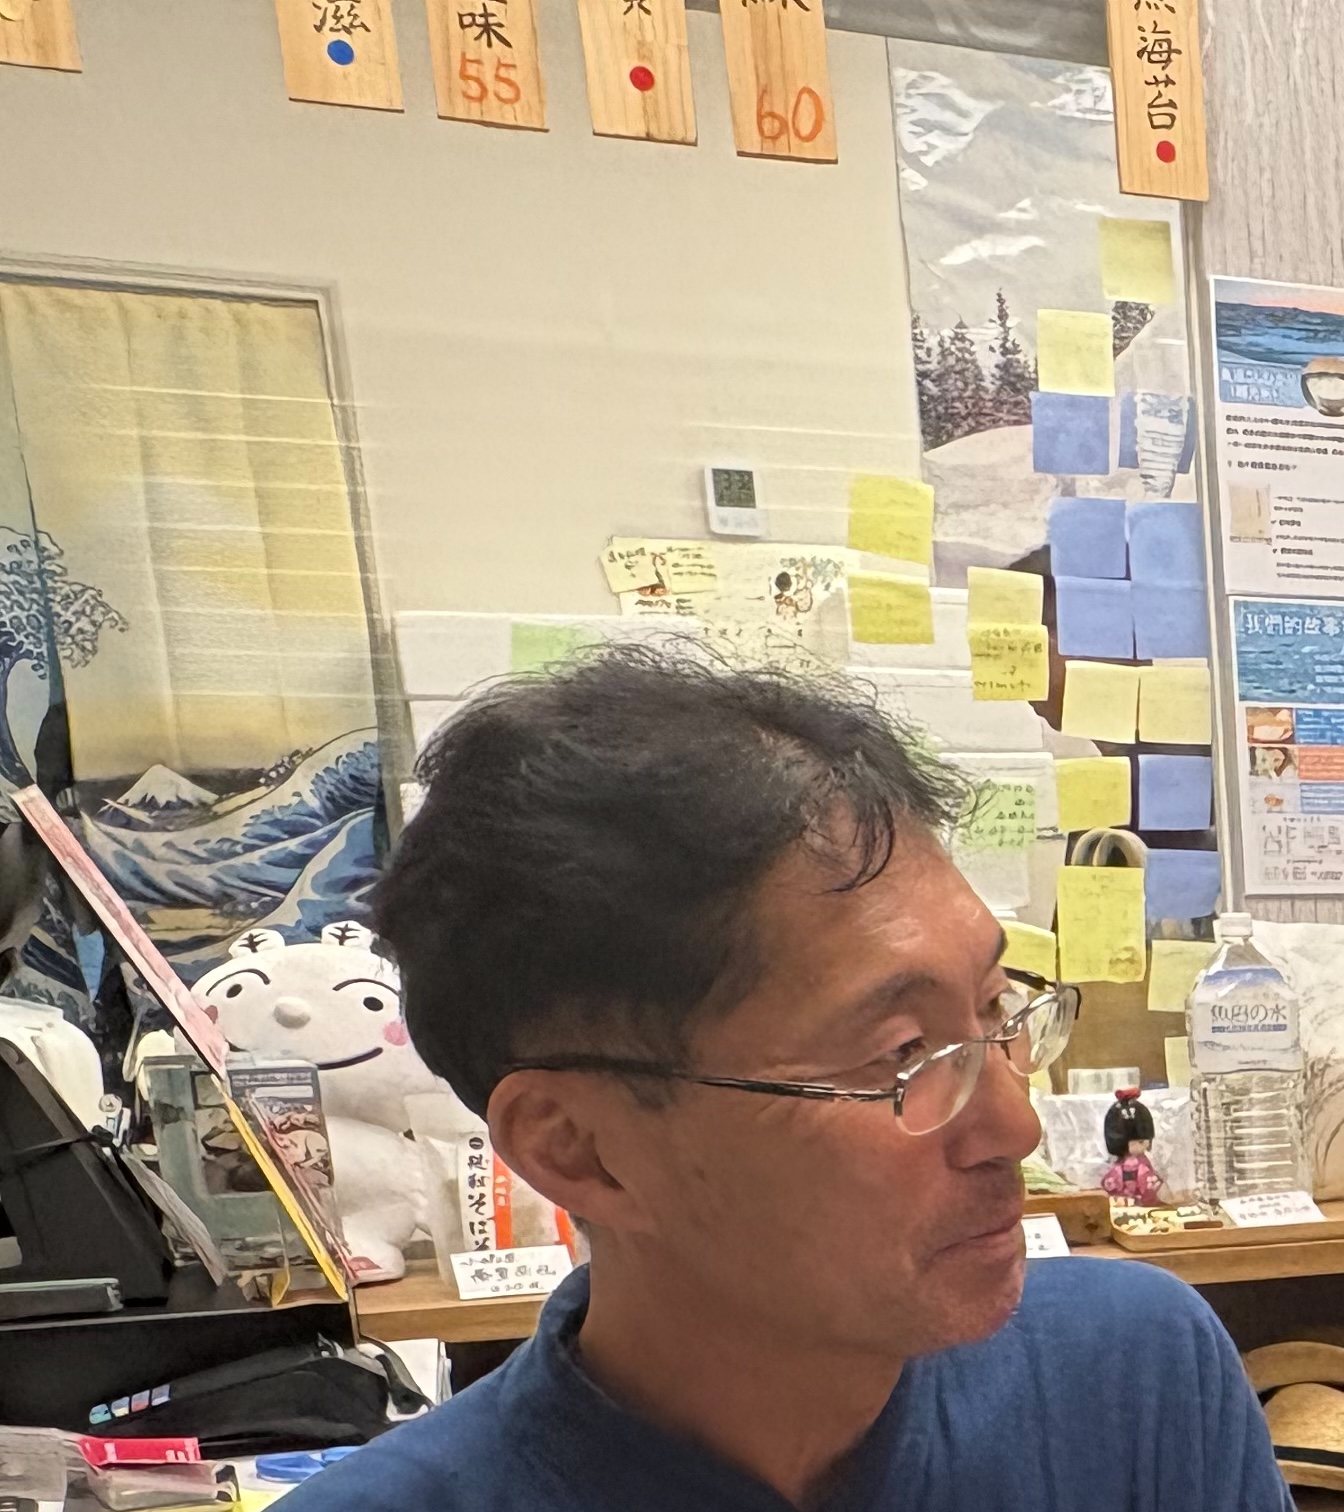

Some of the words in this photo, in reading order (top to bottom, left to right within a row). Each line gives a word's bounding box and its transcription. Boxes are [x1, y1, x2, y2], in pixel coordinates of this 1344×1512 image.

[457, 0, 513, 48] 味
[458, 52, 521, 104] 55
[757, 83, 824, 142] 60
